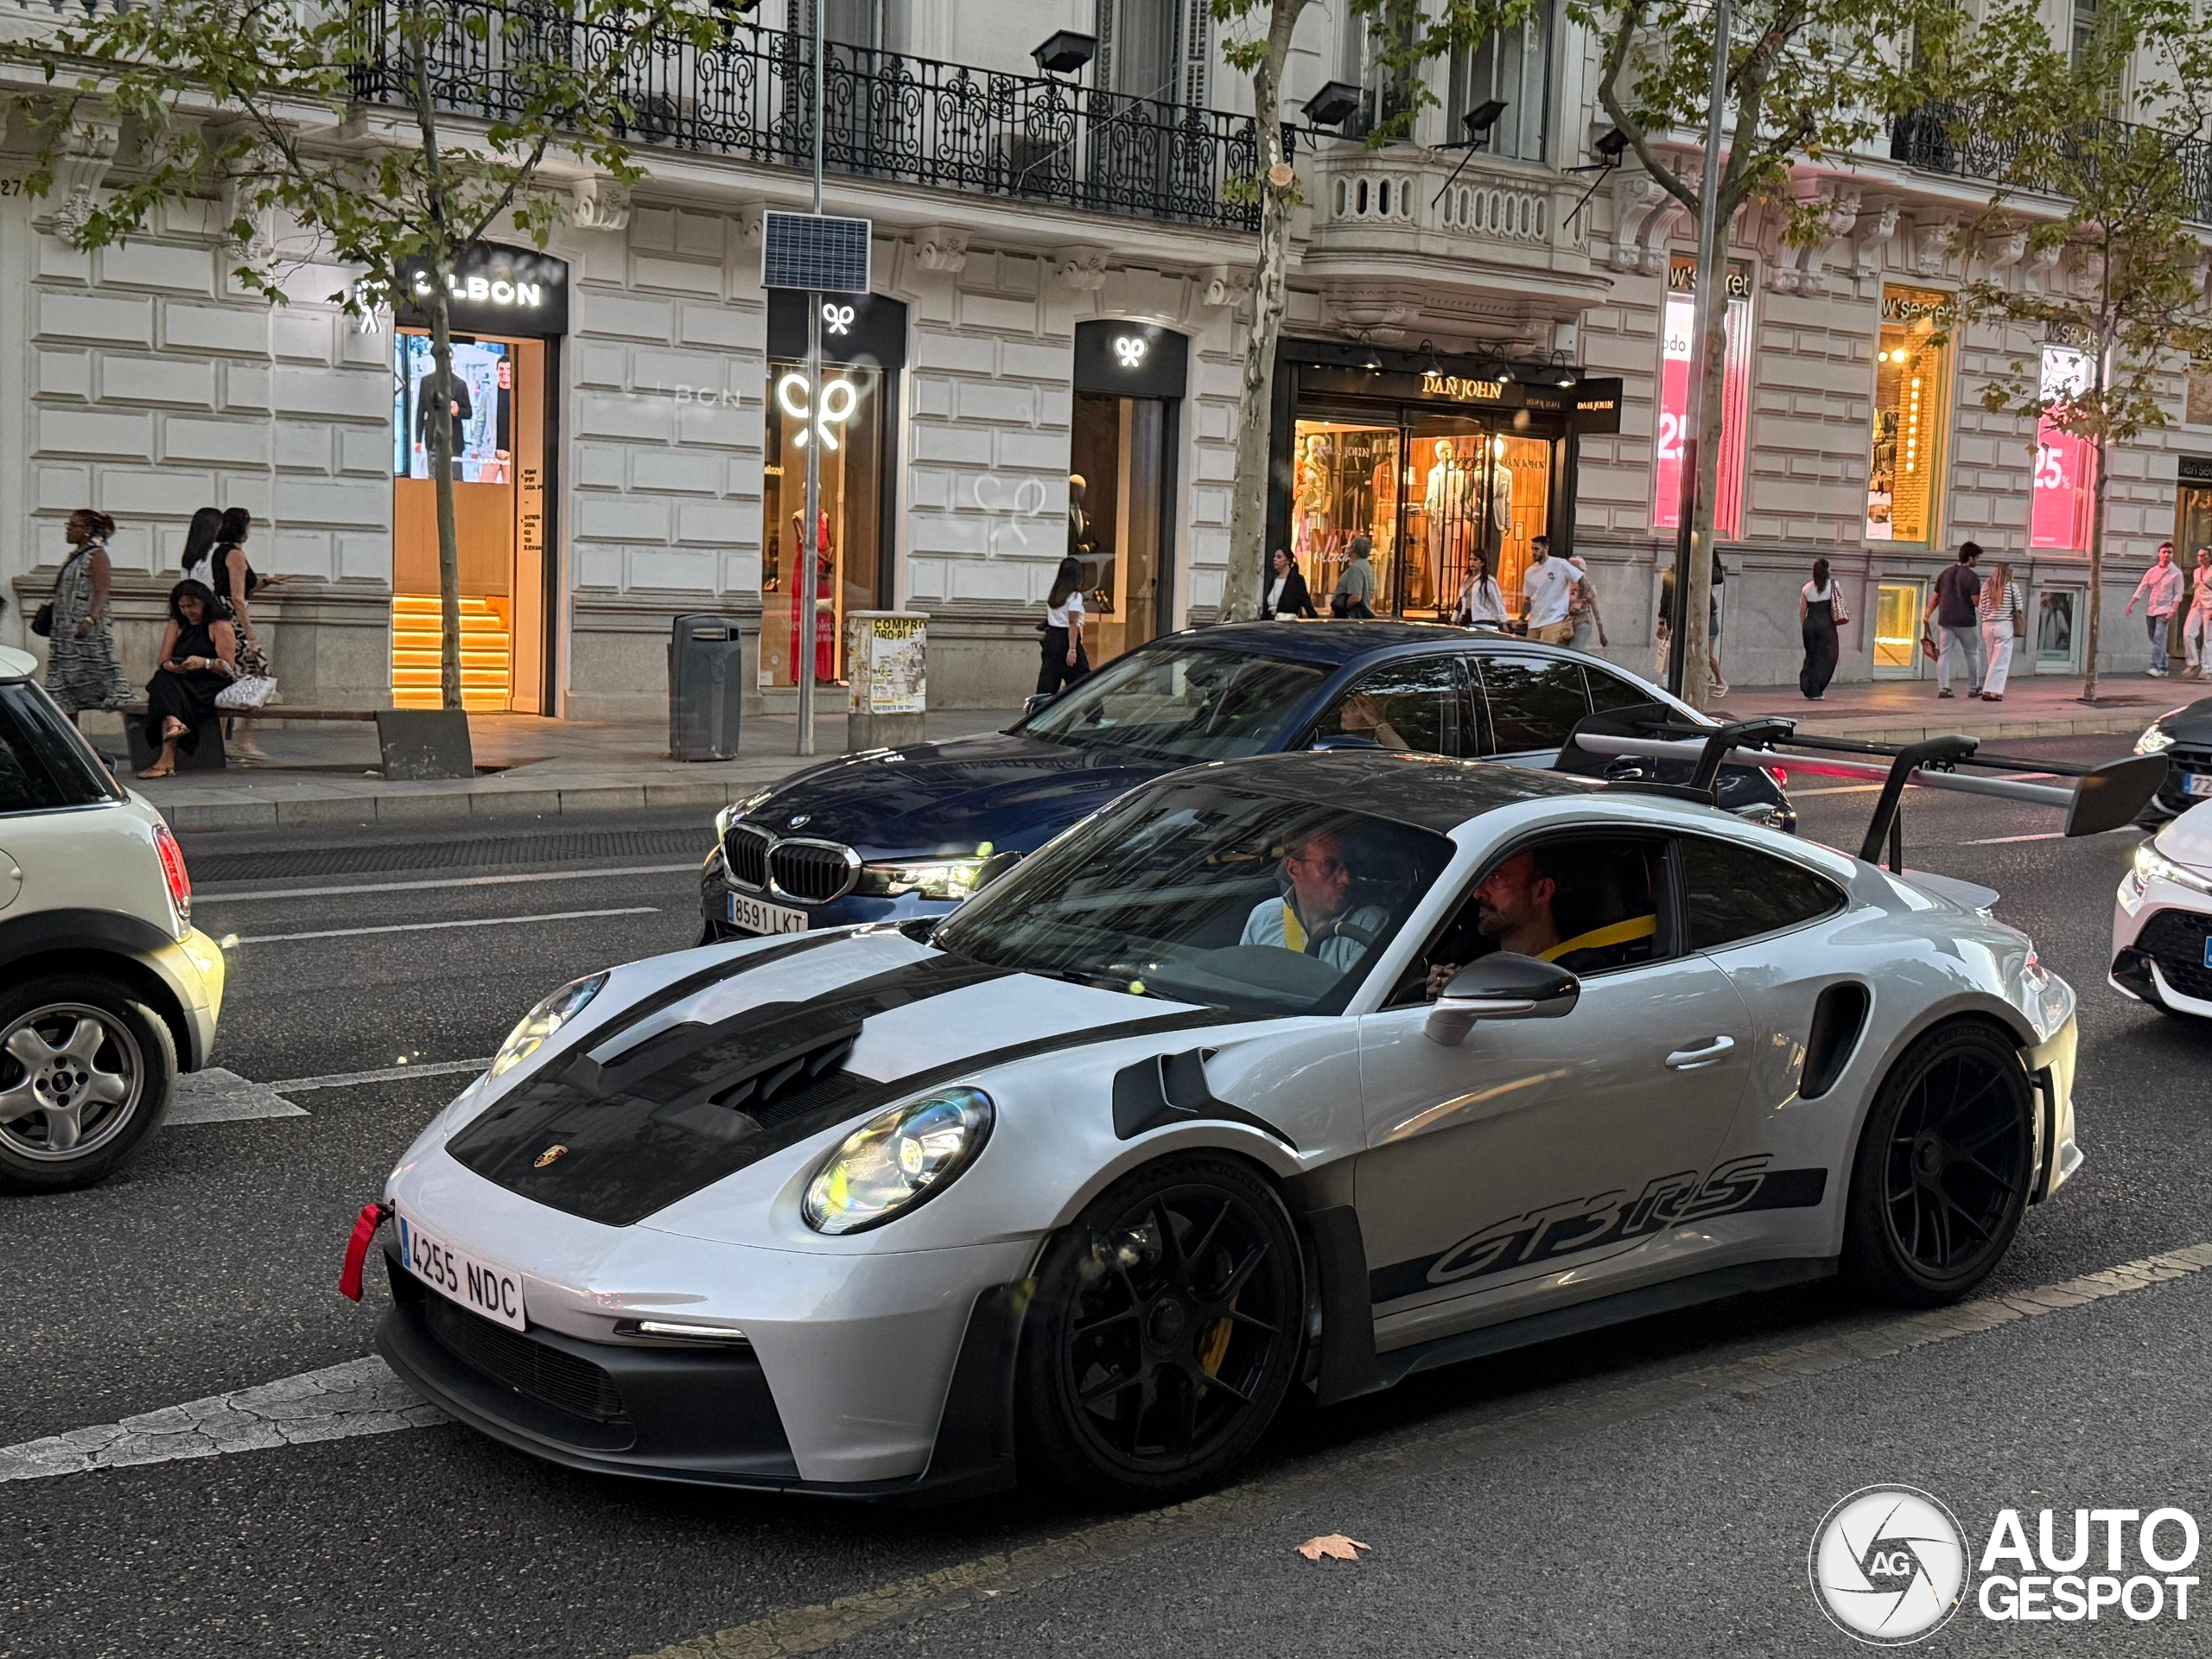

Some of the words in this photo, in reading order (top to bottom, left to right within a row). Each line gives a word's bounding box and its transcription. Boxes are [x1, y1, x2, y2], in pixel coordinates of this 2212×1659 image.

[415, 270, 541, 307] SLBON
[1459, 379, 1503, 400] JOHN
[874, 620, 926, 631] COMPRO
[736, 899, 767, 931] 8591
[773, 910, 804, 934] LKT
[413, 1232, 458, 1293] 4255
[467, 1262, 517, 1319] NDC
